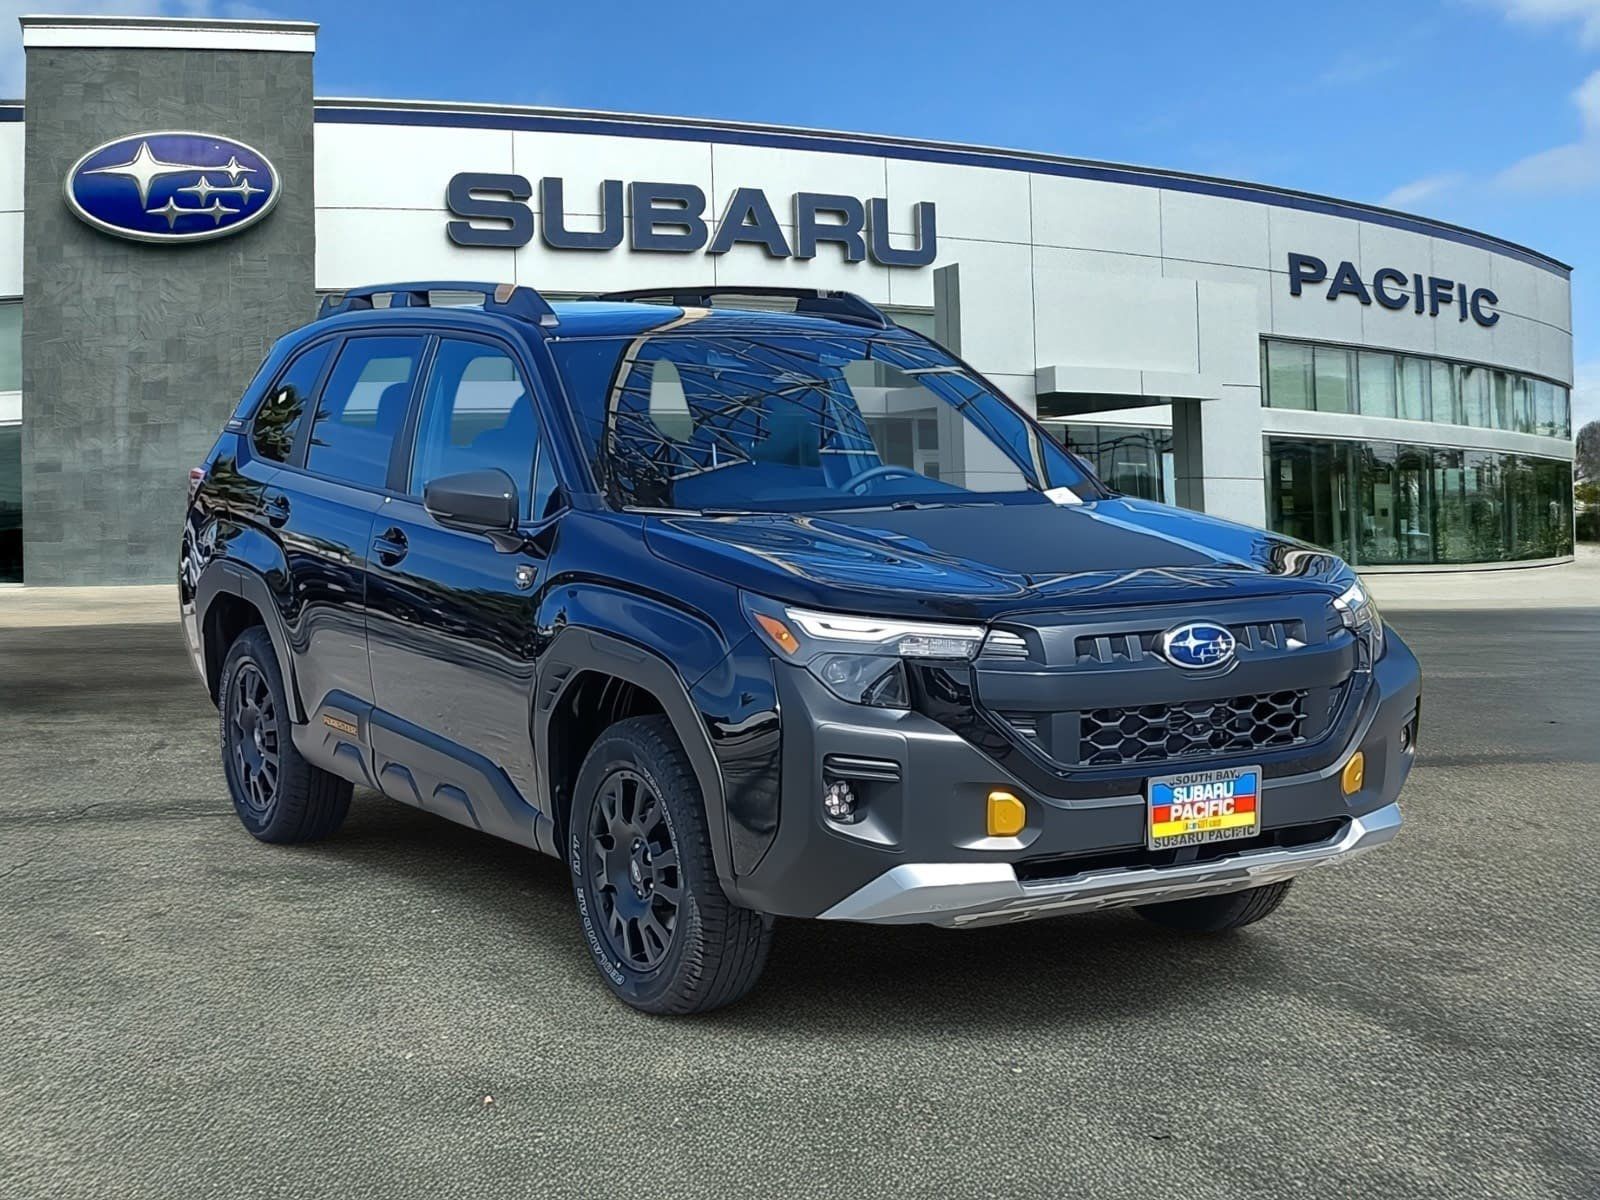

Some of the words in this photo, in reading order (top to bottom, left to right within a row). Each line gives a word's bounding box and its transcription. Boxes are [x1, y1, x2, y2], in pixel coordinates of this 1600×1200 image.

[446, 172, 937, 267] SUBARU
[1287, 251, 1500, 328] PACIFIC
[1175, 773, 1212, 786] SOUTH
[1216, 769, 1237, 780] BAY
[1173, 781, 1234, 804] SUBARU
[1170, 798, 1235, 822] PACIFIC
[1154, 831, 1204, 848] SUBARU
[1208, 826, 1255, 841] PACIFIC
